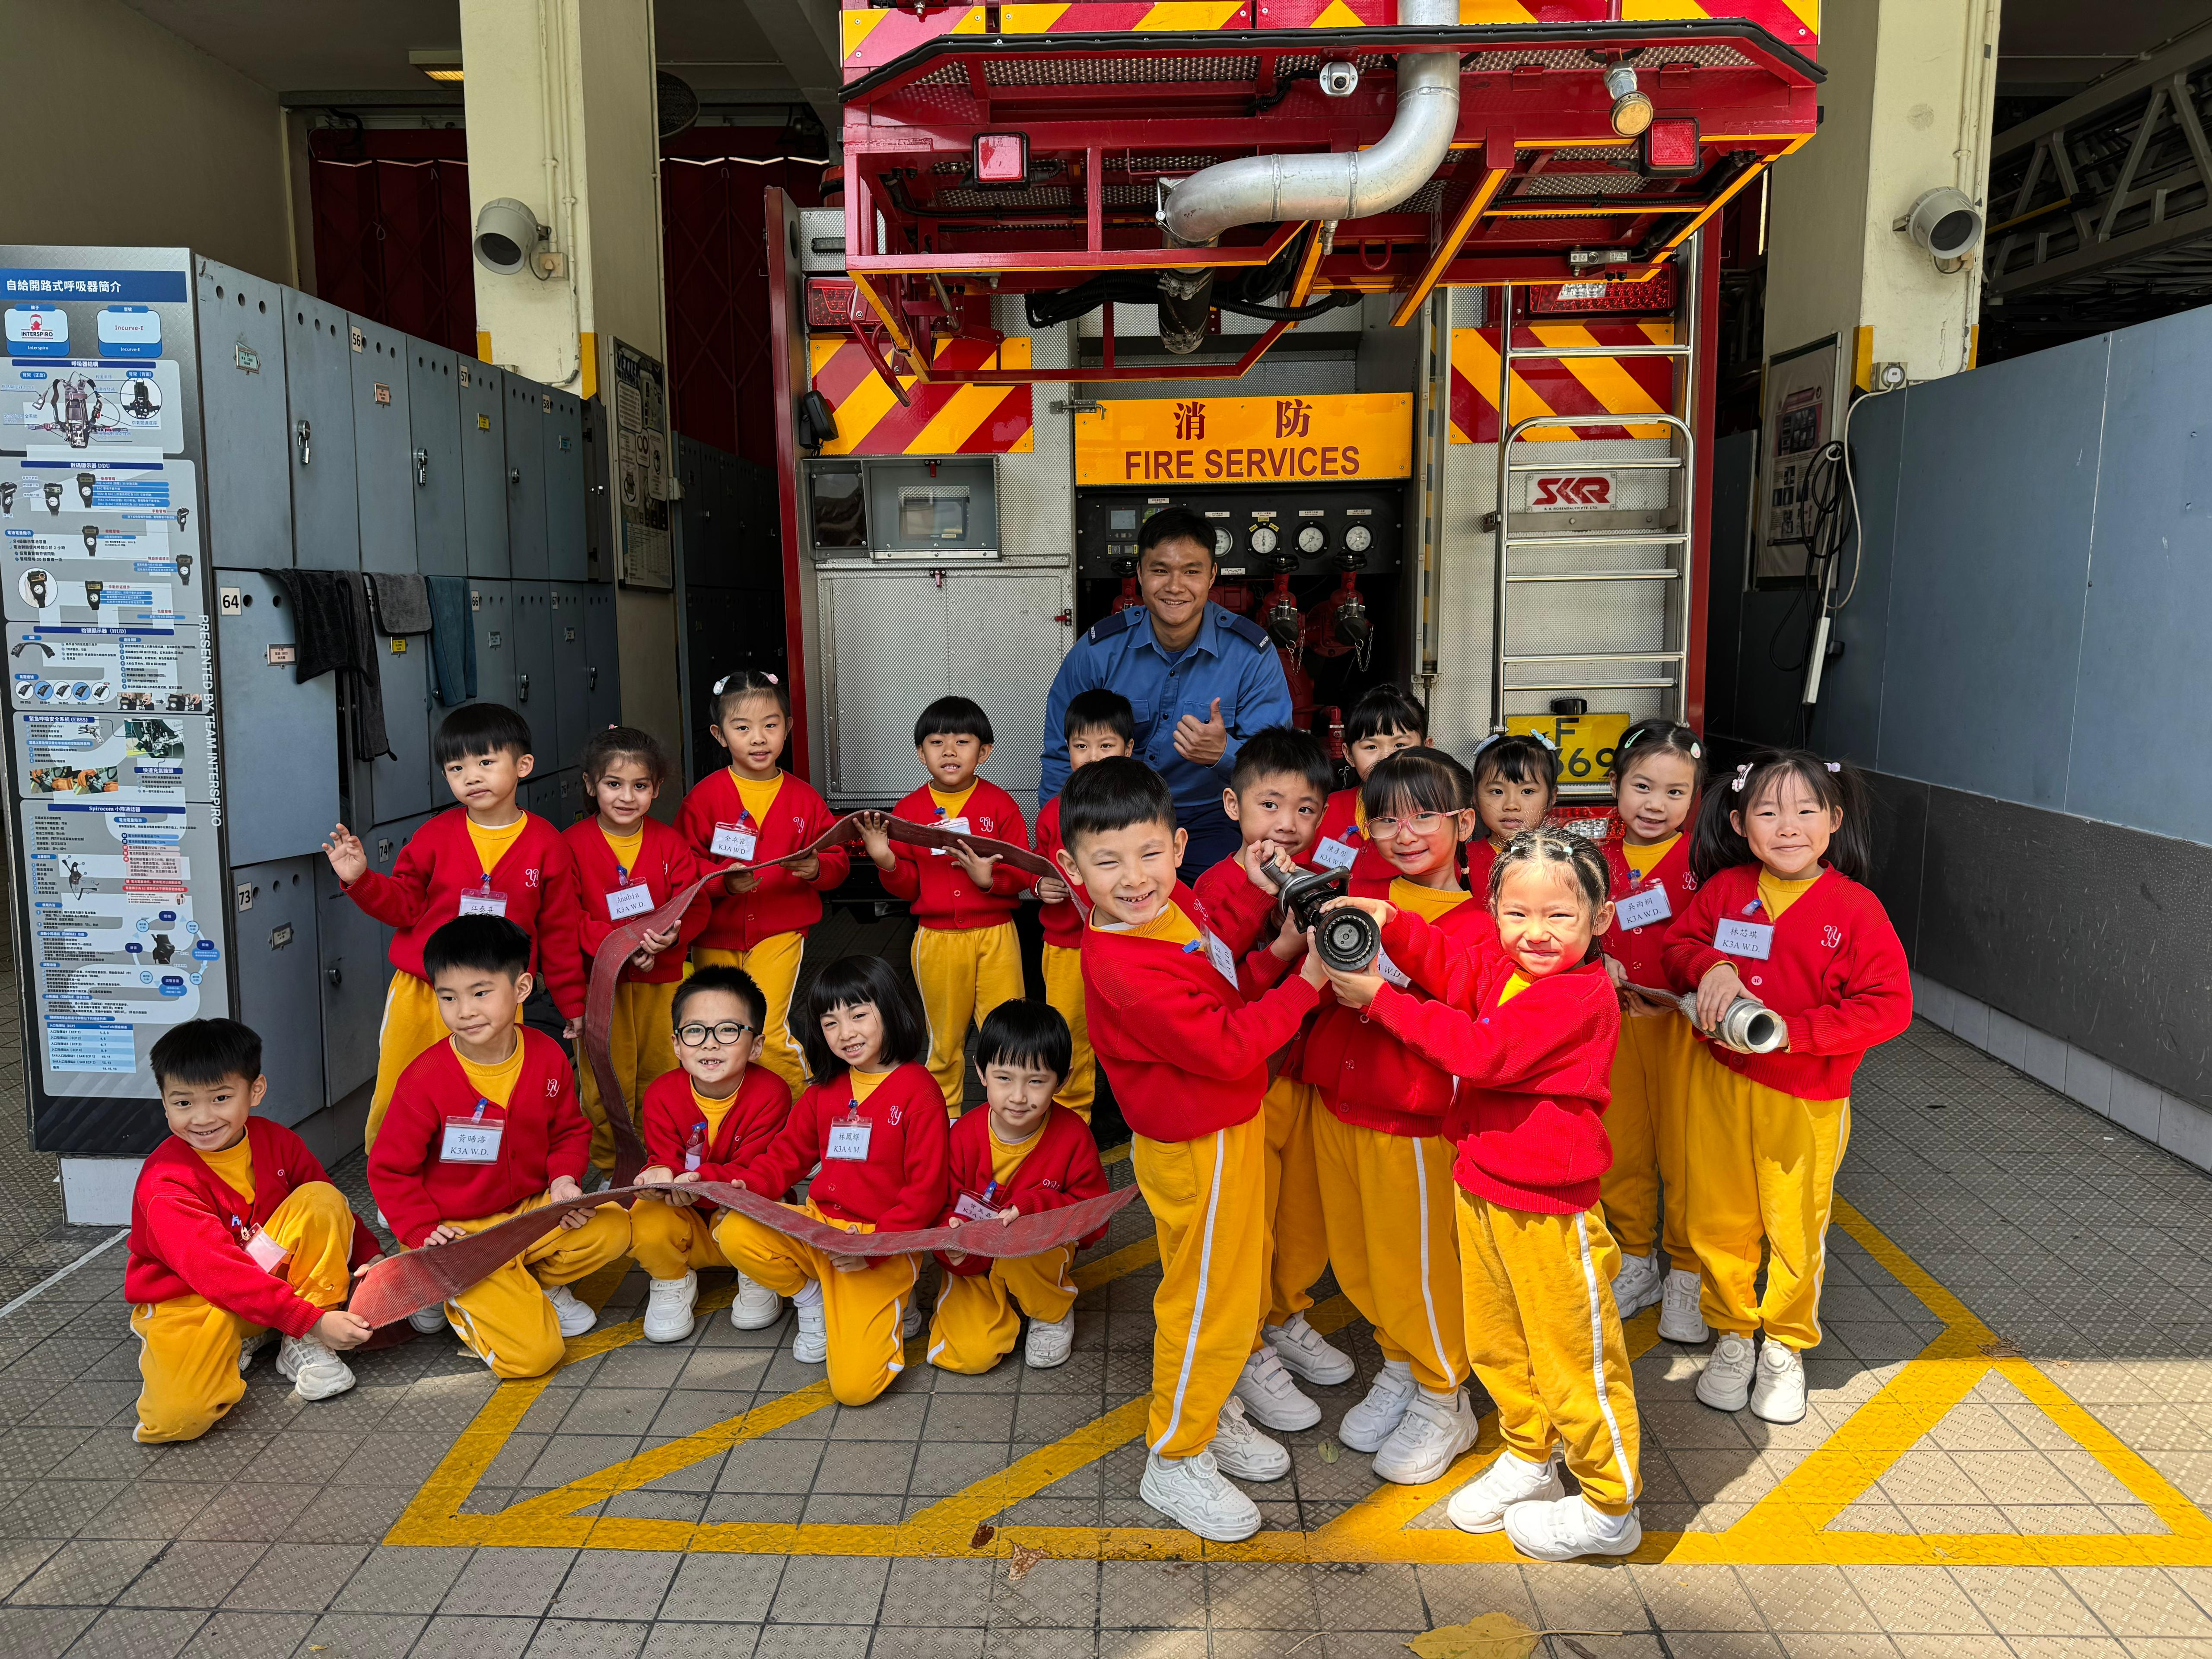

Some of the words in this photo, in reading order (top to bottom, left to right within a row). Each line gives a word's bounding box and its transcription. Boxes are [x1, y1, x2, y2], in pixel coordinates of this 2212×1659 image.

[6, 280, 121, 293] 自給開路式呼吸器簡介
[353, 334, 360, 346] 56
[461, 370, 467, 382] 57
[543, 400, 550, 409] 58
[1125, 450, 1194, 480] FIRE
[1205, 446, 1360, 479] SERVICES
[1532, 477, 1611, 505] SKR
[222, 595, 239, 608] 64
[472, 596, 479, 606] 66
[552, 597, 557, 605] 67
[198, 615, 213, 690] PRESENTED
[203, 693, 214, 712] BY
[205, 712, 217, 749] TEAM
[1556, 718, 1580, 747] F
[207, 752, 222, 827] INTERSPIRO
[379, 846, 388, 857] 74
[239, 890, 251, 906] 73
[617, 893, 639, 903] Anabia
[1627, 914, 1643, 923] K3A
[1723, 940, 1739, 949] K3A
[1742, 943, 1760, 953] W.D.
[1385, 966, 1401, 979] W.D.
